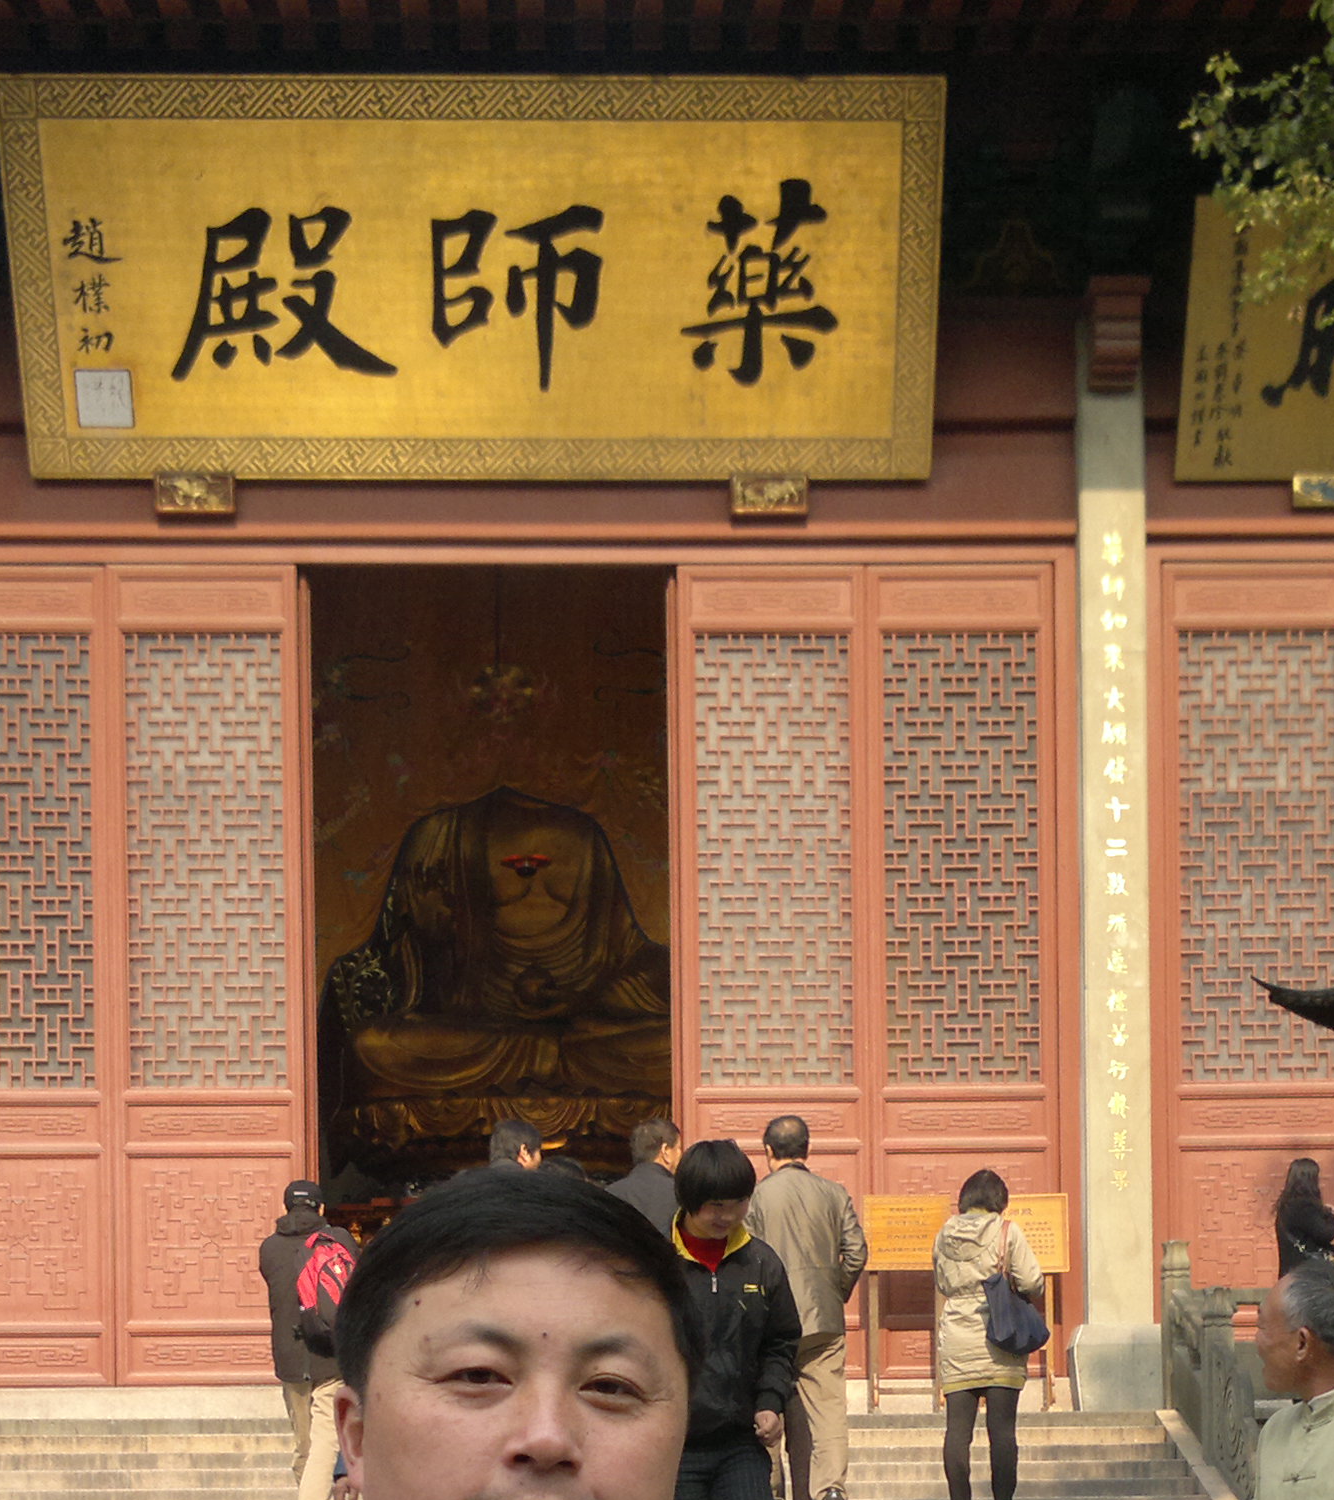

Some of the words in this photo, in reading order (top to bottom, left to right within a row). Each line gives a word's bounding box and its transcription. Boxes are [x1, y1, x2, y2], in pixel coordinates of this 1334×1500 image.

[62, 216, 123, 353] 趙樸初
[171, 178, 839, 392] 藥師殿
